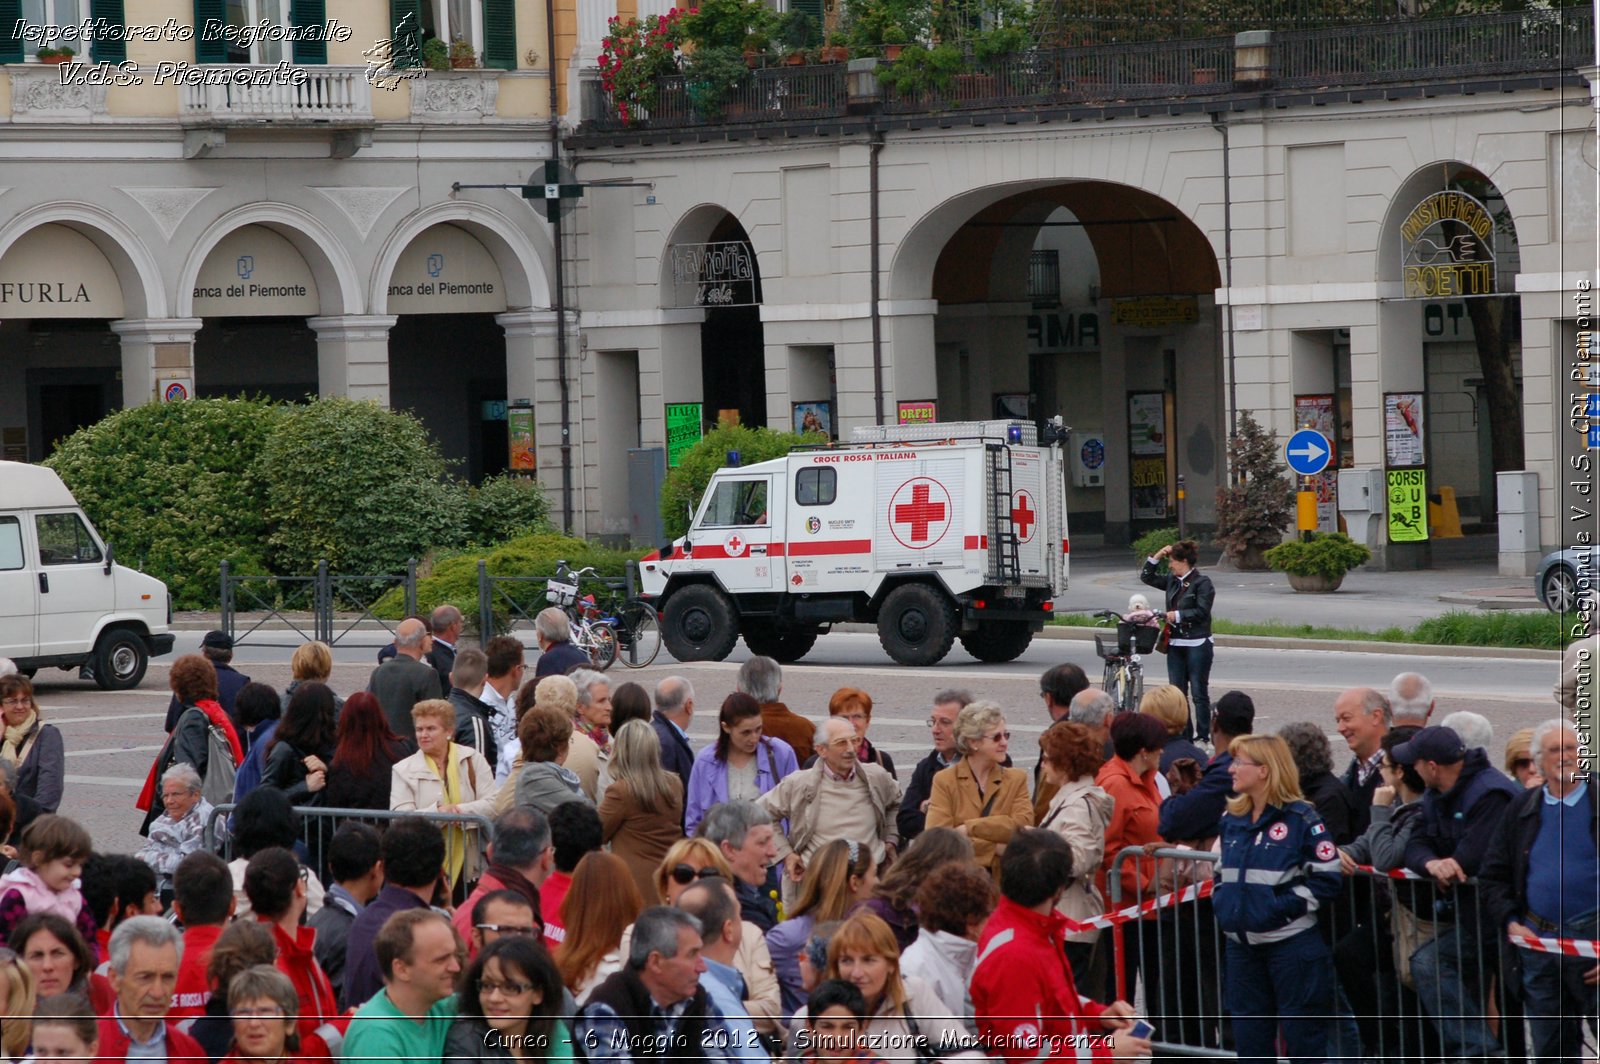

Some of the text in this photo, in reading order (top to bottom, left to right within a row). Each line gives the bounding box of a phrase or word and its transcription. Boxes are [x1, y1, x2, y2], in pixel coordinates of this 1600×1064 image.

[1402, 194, 1492, 243] PASTIFICIO
[0, 282, 91, 303] FURLA
[192, 284, 307, 298] anca del Piemonte
[417, 282, 435, 296] del
[438, 281, 494, 295] Piemonte
[900, 407, 933, 419] ORFEI
[813, 452, 917, 464] CROCE ROSSA ITALIANA
[1387, 471, 1423, 487] CORSI
